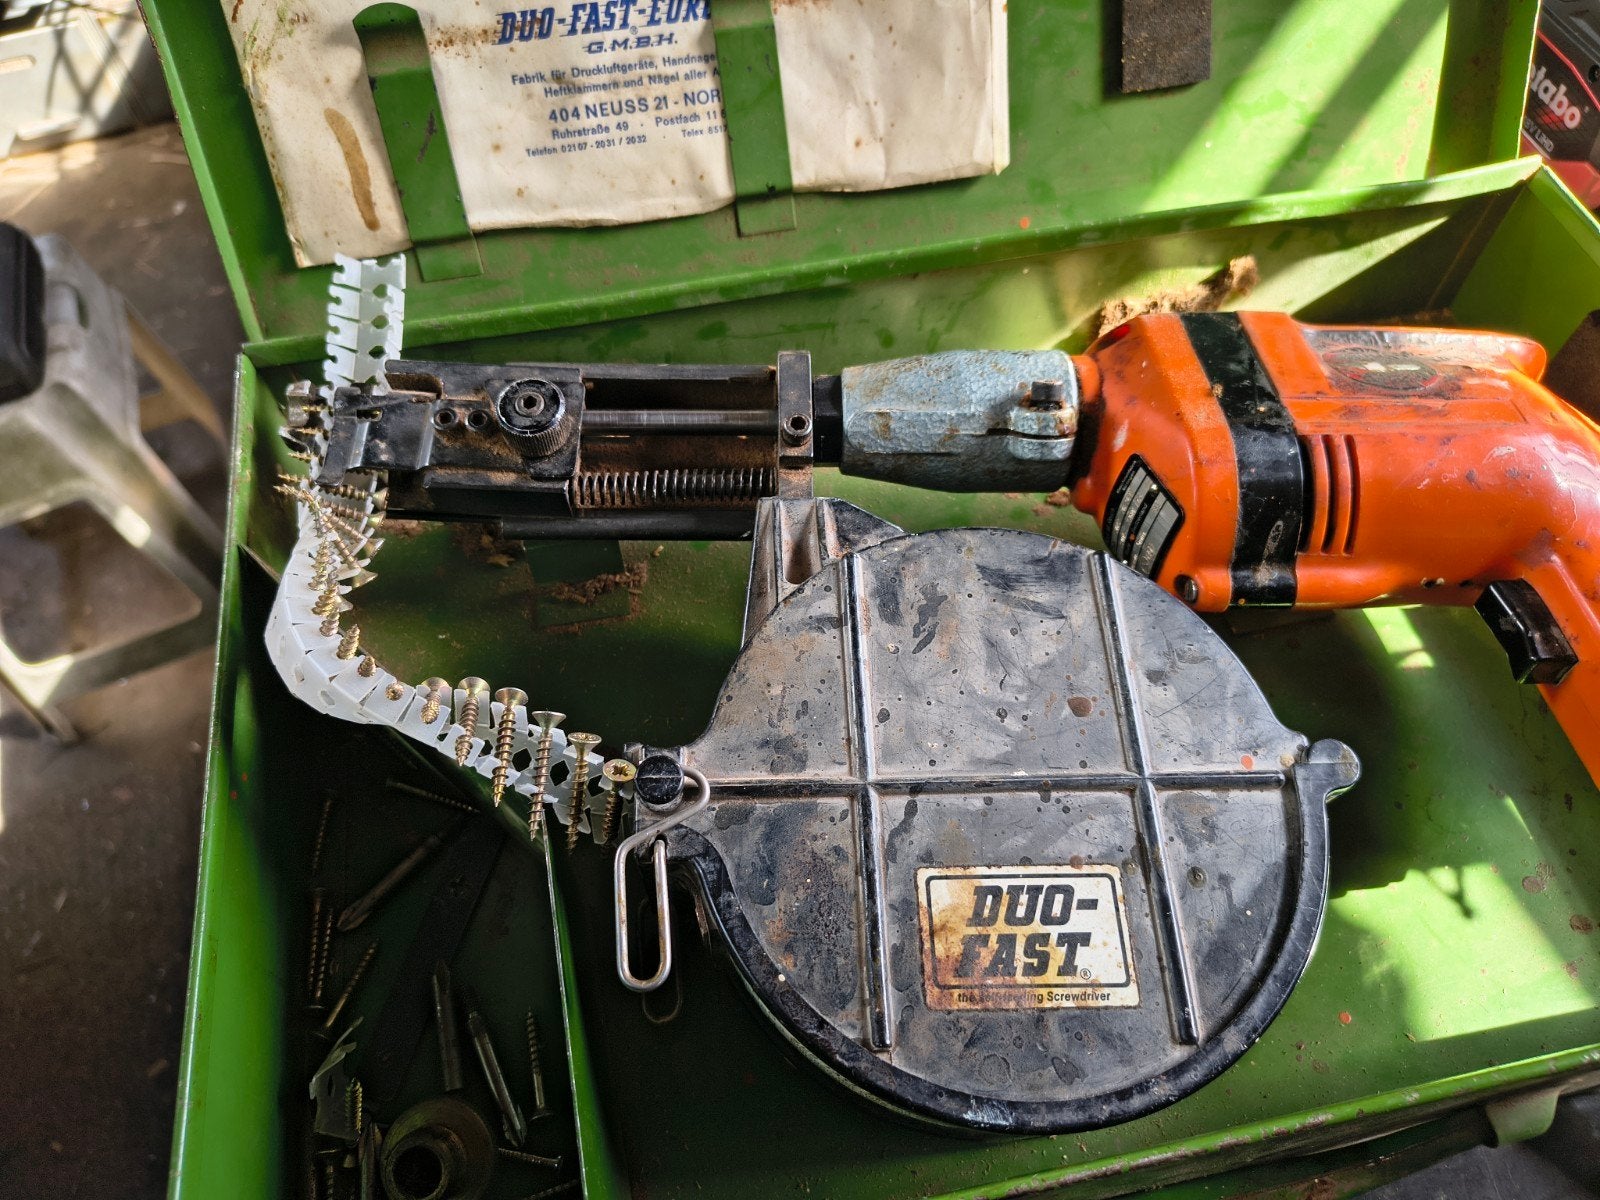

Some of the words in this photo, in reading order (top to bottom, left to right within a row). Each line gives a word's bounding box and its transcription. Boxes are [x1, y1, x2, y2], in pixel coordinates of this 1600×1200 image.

[584, 32, 678, 54] G.M.B.H.
[511, 72, 546, 85] Fabrik
[551, 68, 566, 80] für
[571, 59, 657, 79] Druckluftgeräte,
[544, 80, 620, 98] Heftklammern
[624, 76, 644, 88] und
[648, 71, 680, 86] Nägel
[684, 69, 707, 80] aller
[549, 105, 580, 123] 404
[585, 97, 649, 119] NEUSS
[653, 94, 669, 111] 21
[684, 87, 721, 108] NOR
[552, 123, 610, 140] Ruhrstraße
[615, 121, 629, 133] 49
[655, 112, 701, 128] Postfach
[525, 145, 558, 158] Telefon
[625, 134, 647, 146] 2032
[681, 128, 704, 139] Telex
[966, 883, 1099, 928] DUO-
[954, 931, 1092, 978] FAST
[957, 992, 977, 1004] the
[1046, 990, 1110, 1003] Screwdriver
